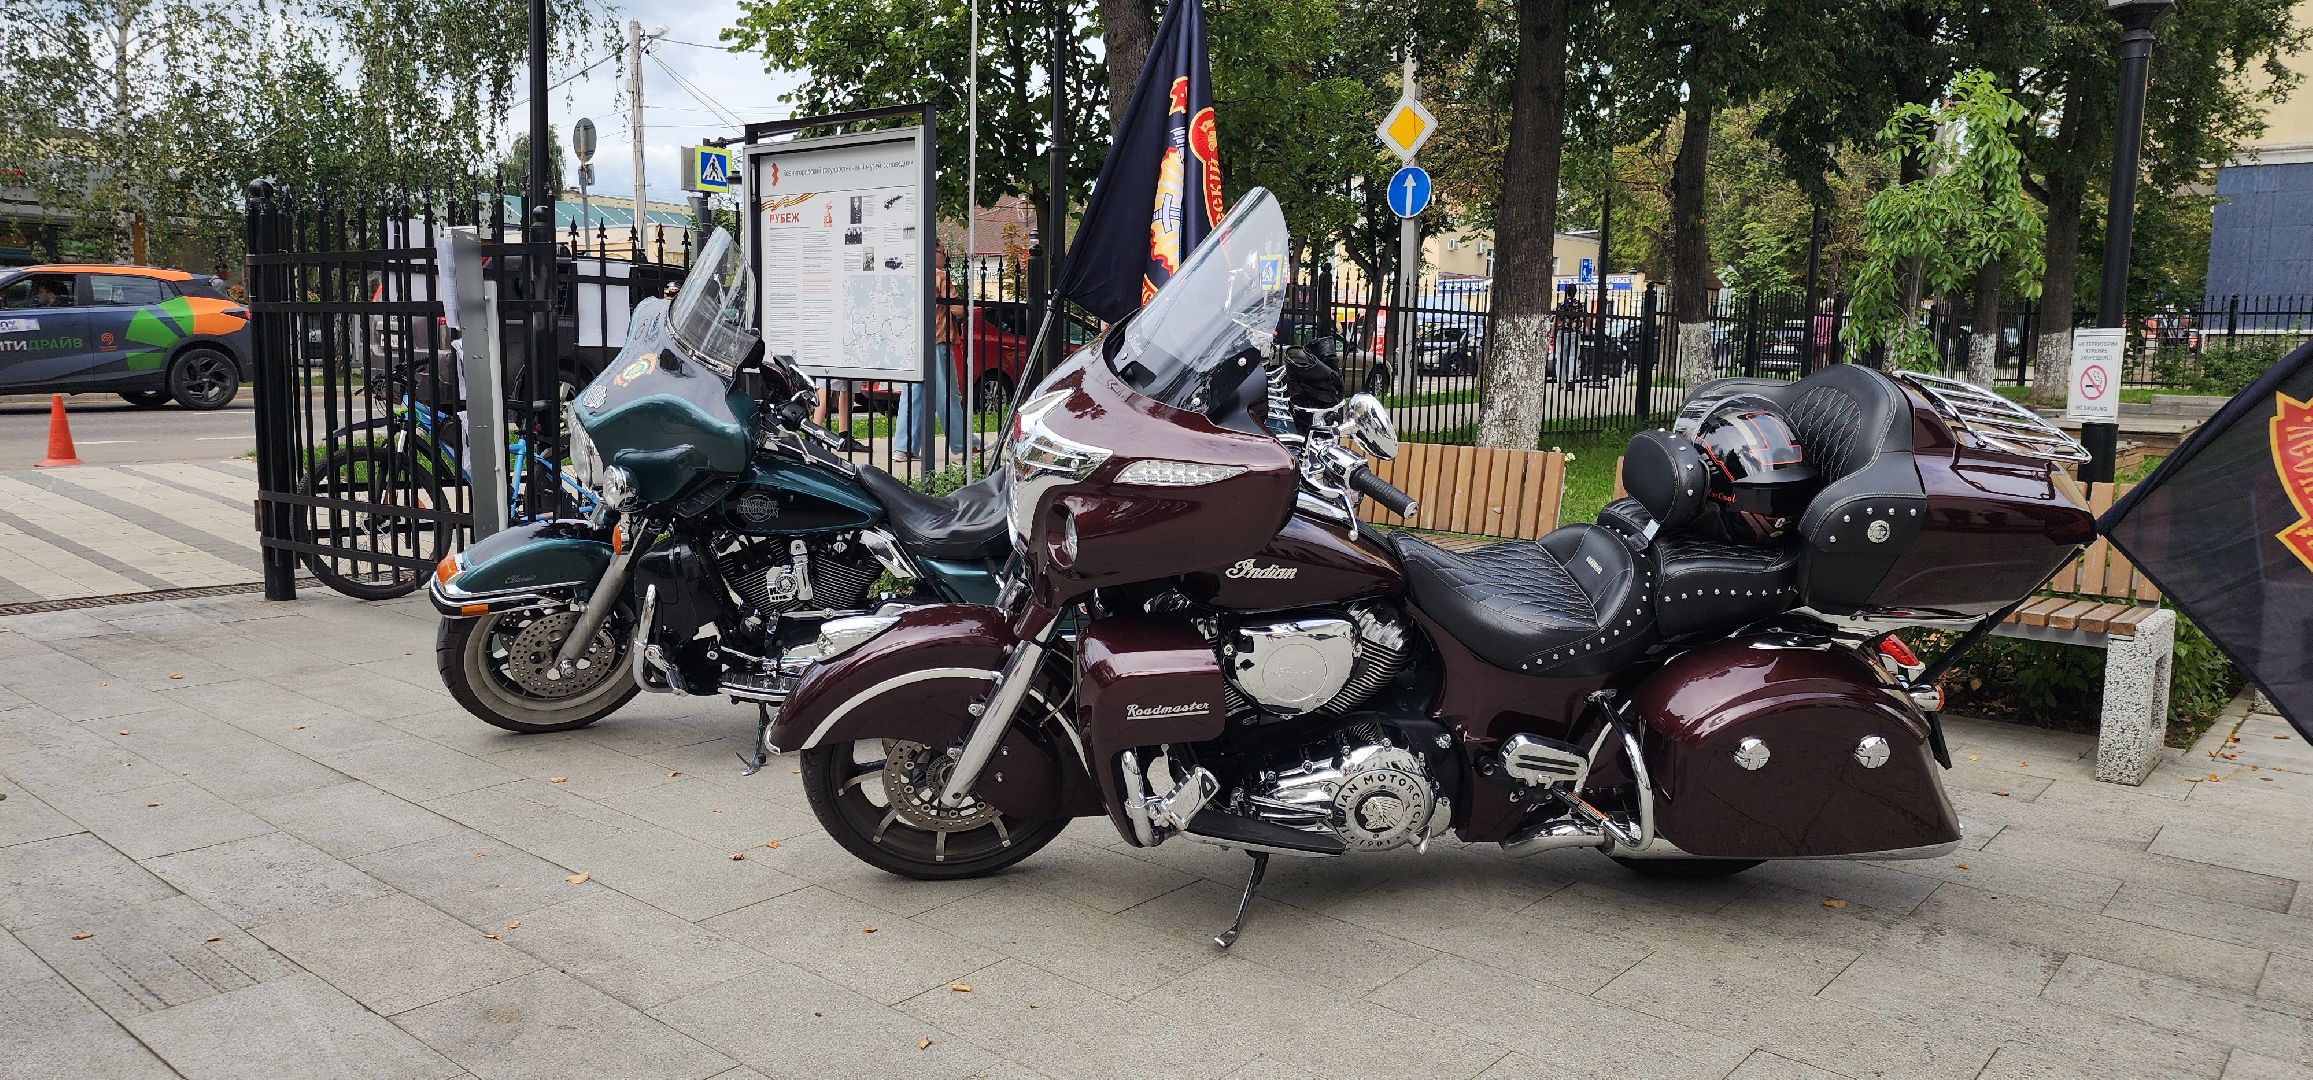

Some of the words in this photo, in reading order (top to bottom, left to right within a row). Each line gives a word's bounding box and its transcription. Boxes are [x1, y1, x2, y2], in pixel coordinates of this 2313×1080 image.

[770, 212, 800, 224] РУБЕЖ
[1225, 558, 1298, 580] Indian
[1126, 701, 1210, 718] Roadmaster
[1336, 784, 1359, 834] INDIAN
[1363, 773, 1422, 834] MOTORCYCLE
[1359, 839, 1392, 847] 1901
